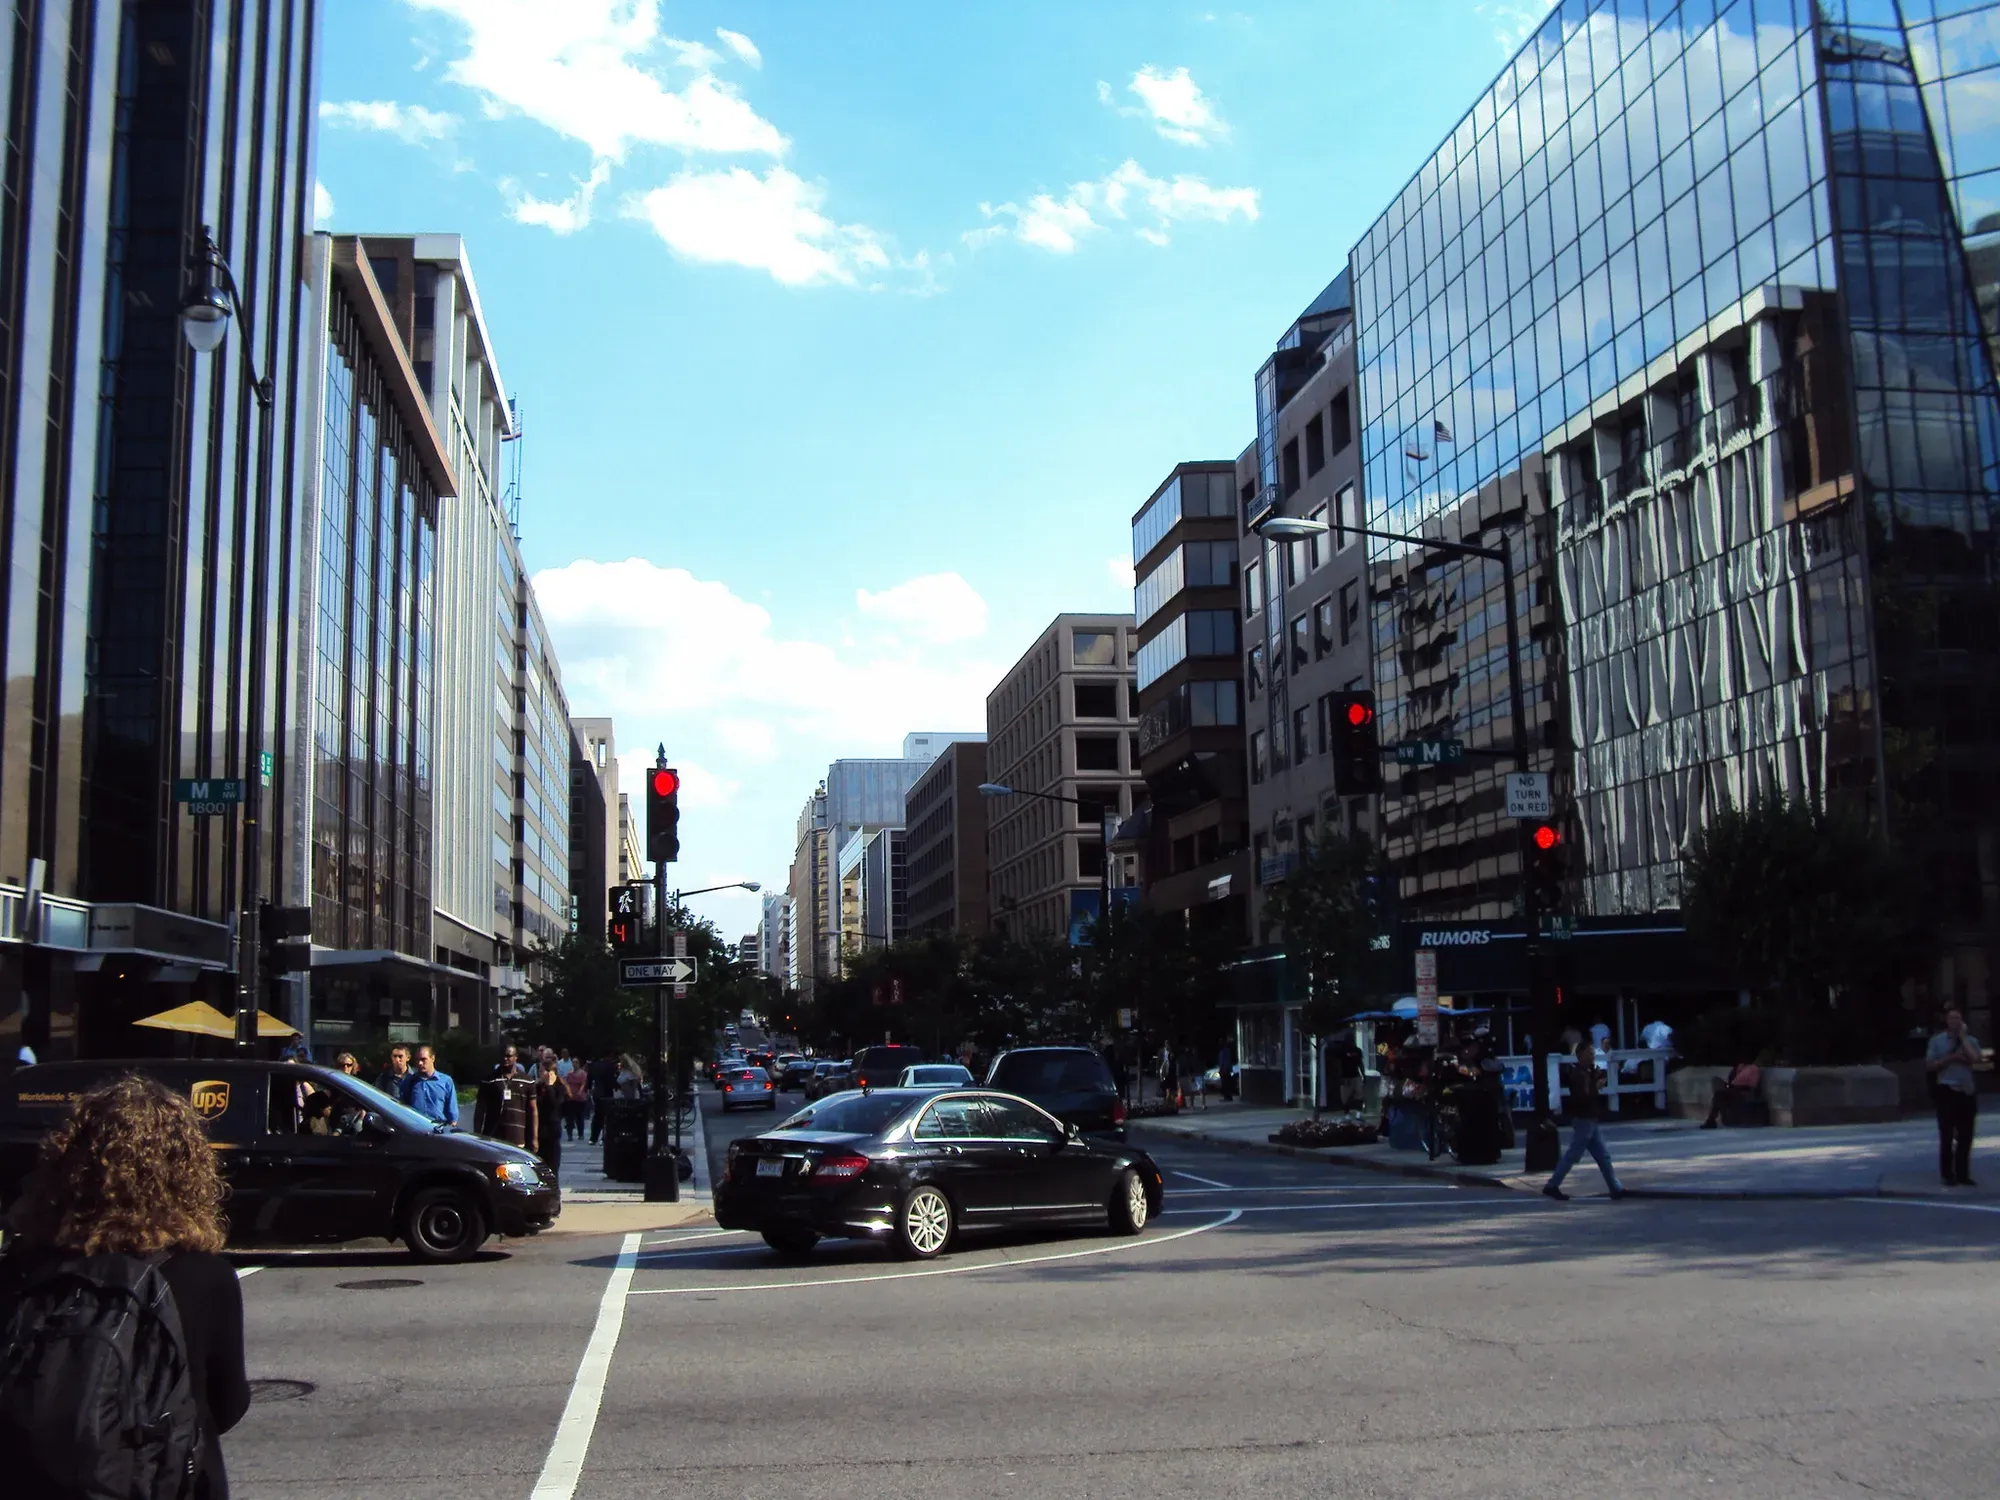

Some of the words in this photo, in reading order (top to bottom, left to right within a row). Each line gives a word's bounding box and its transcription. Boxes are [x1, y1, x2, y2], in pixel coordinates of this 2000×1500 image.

[1398, 747, 1415, 758] NW
[1422, 742, 1441, 762] M
[1448, 745, 1462, 758] ST
[1519, 777, 1535, 787] NO
[191, 782, 209, 799] M
[1515, 790, 1541, 799] TURN
[190, 802, 226, 814] 1800
[1510, 803, 1524, 812] ON
[1528, 802, 1548, 812] RED
[1420, 930, 1491, 946] RUMORS
[627, 967, 649, 977] ONE
[653, 966, 674, 976] WAY
[193, 1092, 227, 1114] ups
